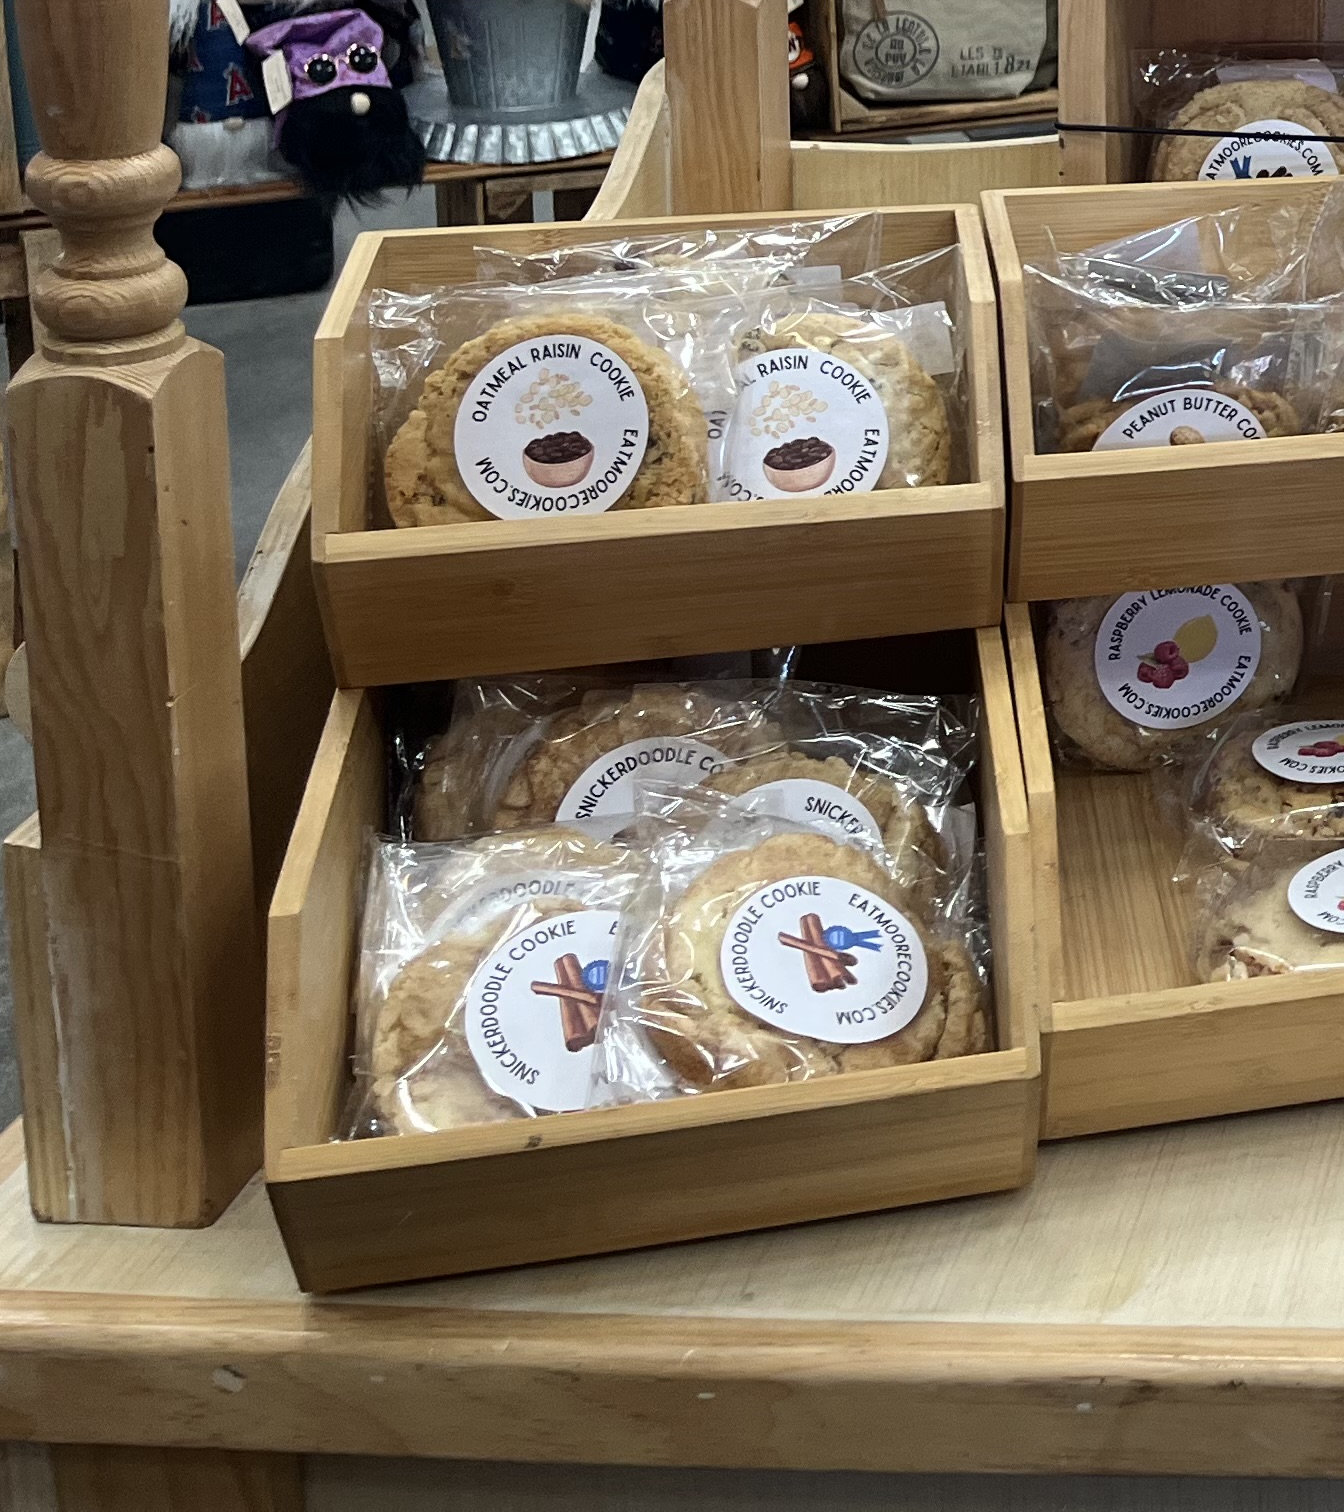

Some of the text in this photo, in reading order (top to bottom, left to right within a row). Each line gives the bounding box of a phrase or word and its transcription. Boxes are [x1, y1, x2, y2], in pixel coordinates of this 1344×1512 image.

[472, 342, 635, 424] OATMEAL RAISIN COOKIE
[755, 354, 873, 405] RAISIN COOKIE
[1122, 396, 1238, 440] PEANUT BUTTER
[474, 428, 640, 513] EATMOORECOOKIES.COM
[1107, 596, 1150, 661] RASPBERRY
[1220, 594, 1253, 637] COOKIE
[1118, 654, 1252, 719] EATMOORECOOKIES.COM
[574, 749, 698, 821] SNICKERDOODLE
[507, 918, 576, 962] COOKIE
[727, 880, 821, 1016] SNICKERDOODLE COOKIE
[834, 892, 914, 1026] EATMOORECOOKIES.COM
[478, 959, 541, 1086] SNICKERDOODLE
